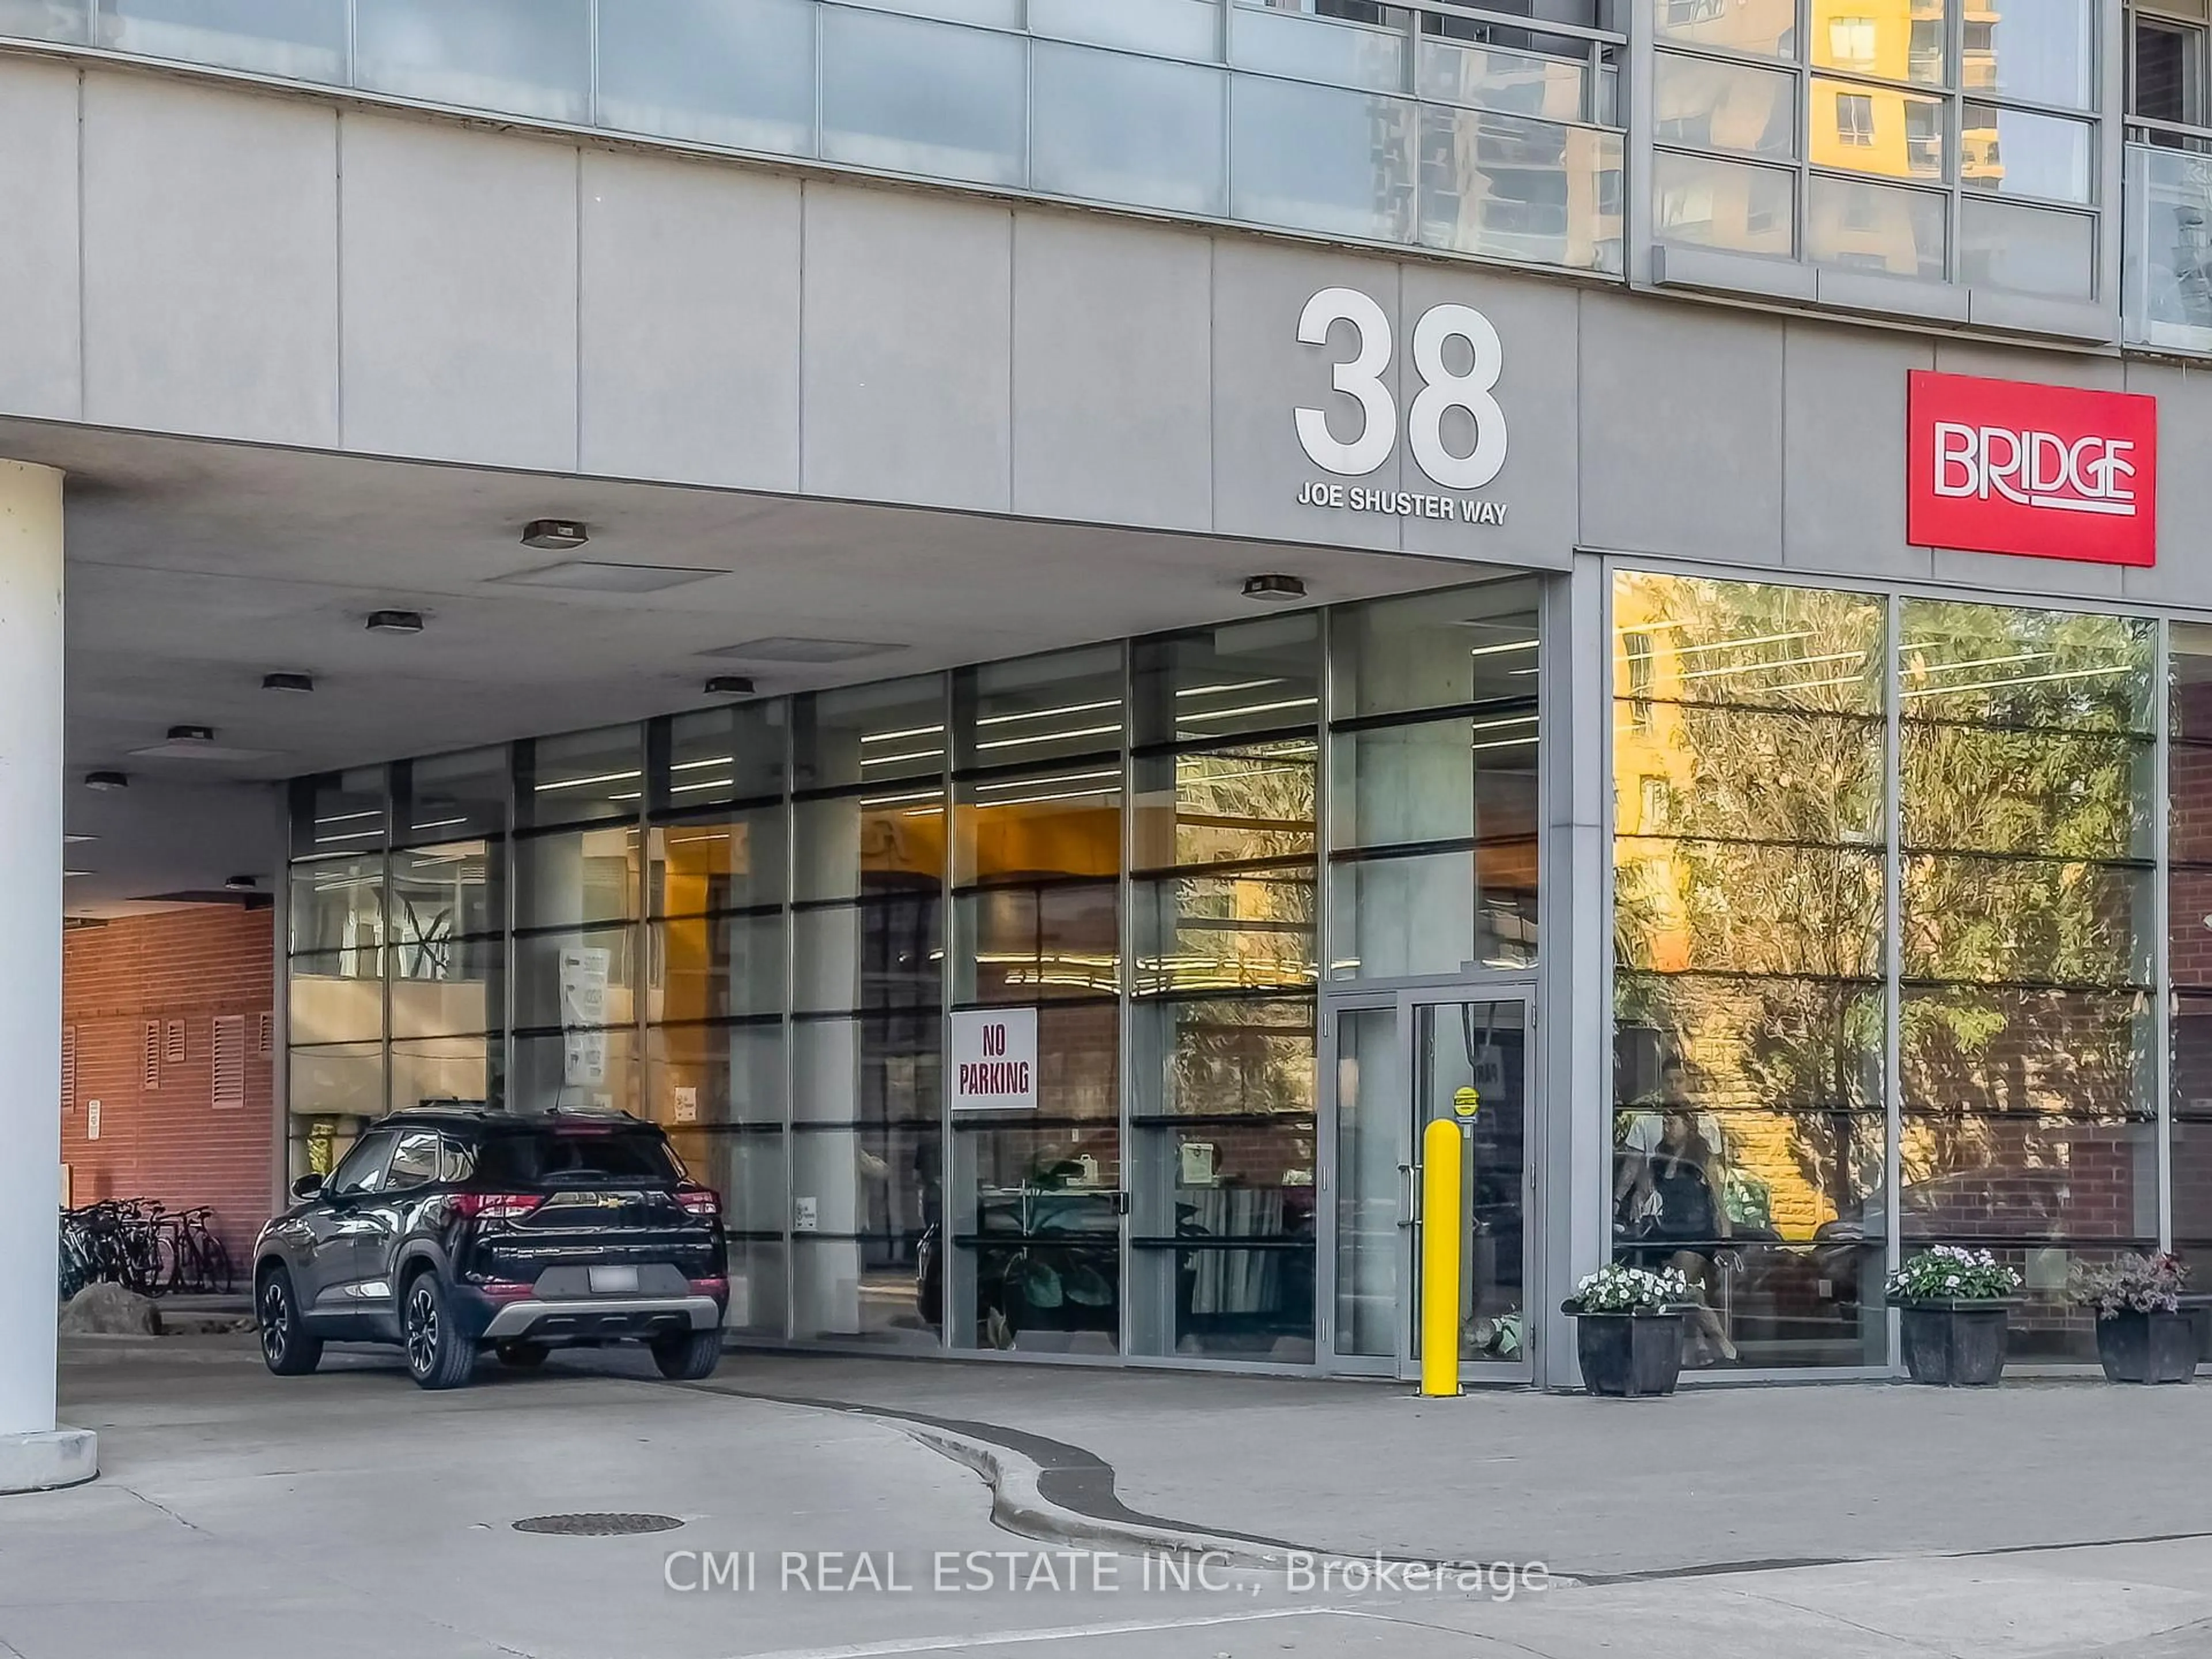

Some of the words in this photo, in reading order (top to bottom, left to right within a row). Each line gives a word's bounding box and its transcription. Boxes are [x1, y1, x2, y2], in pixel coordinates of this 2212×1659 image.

[1294, 287, 1508, 490] 38
[1934, 422, 2137, 516] BRIDGE
[1298, 482, 1343, 507] JOE
[1349, 487, 1455, 520] SHUSTER
[1461, 499, 1507, 525] WAY
[983, 1024, 1005, 1056] NO
[960, 1061, 1029, 1095] PARKING
